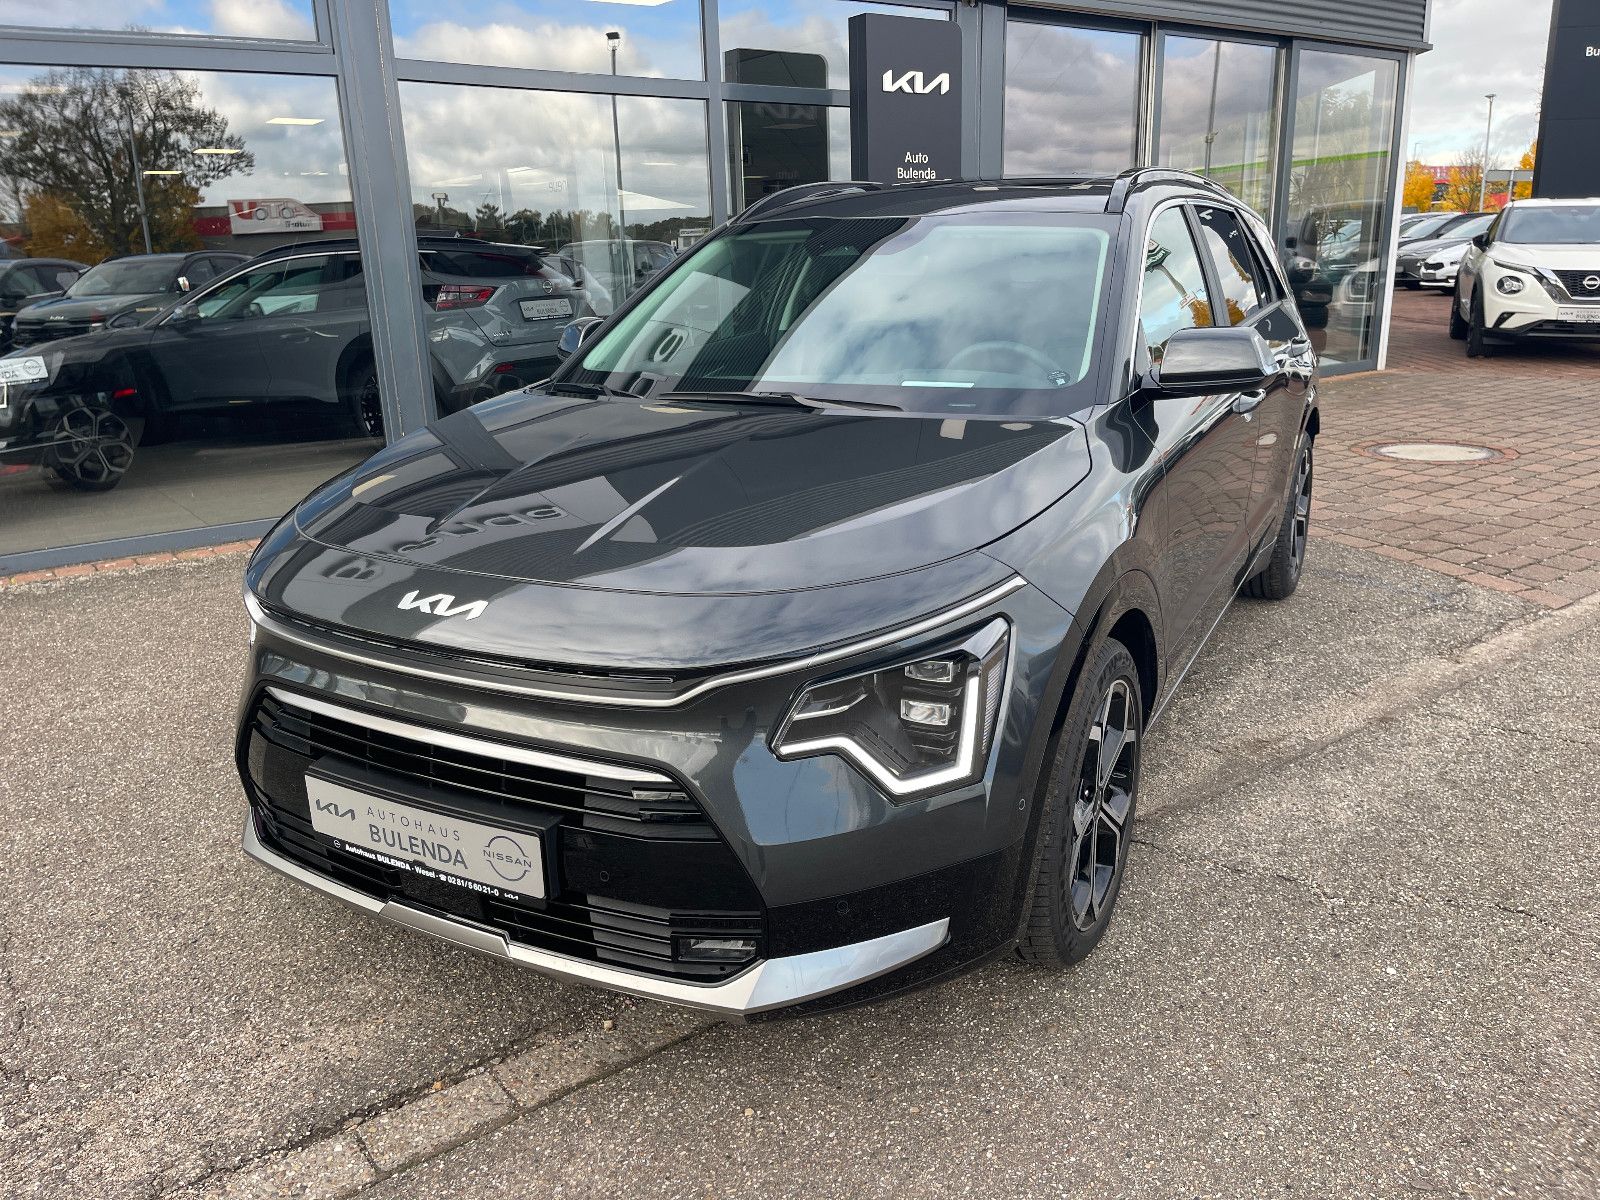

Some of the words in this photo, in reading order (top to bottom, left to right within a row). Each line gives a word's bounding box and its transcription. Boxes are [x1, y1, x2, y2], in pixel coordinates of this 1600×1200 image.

[883, 69, 949, 95] KIA
[905, 152, 929, 164] Auto
[897, 167, 937, 180] Bulenda
[397, 590, 489, 621] KIA
[315, 799, 356, 822] KIA
[367, 806, 461, 842] AUTOHAUS
[368, 823, 469, 870] BULENDA
[482, 849, 533, 869] NISSAN
[345, 844, 377, 861] Autohaus
[376, 854, 412, 872] BULENDA
[414, 865, 436, 879] Wesel
